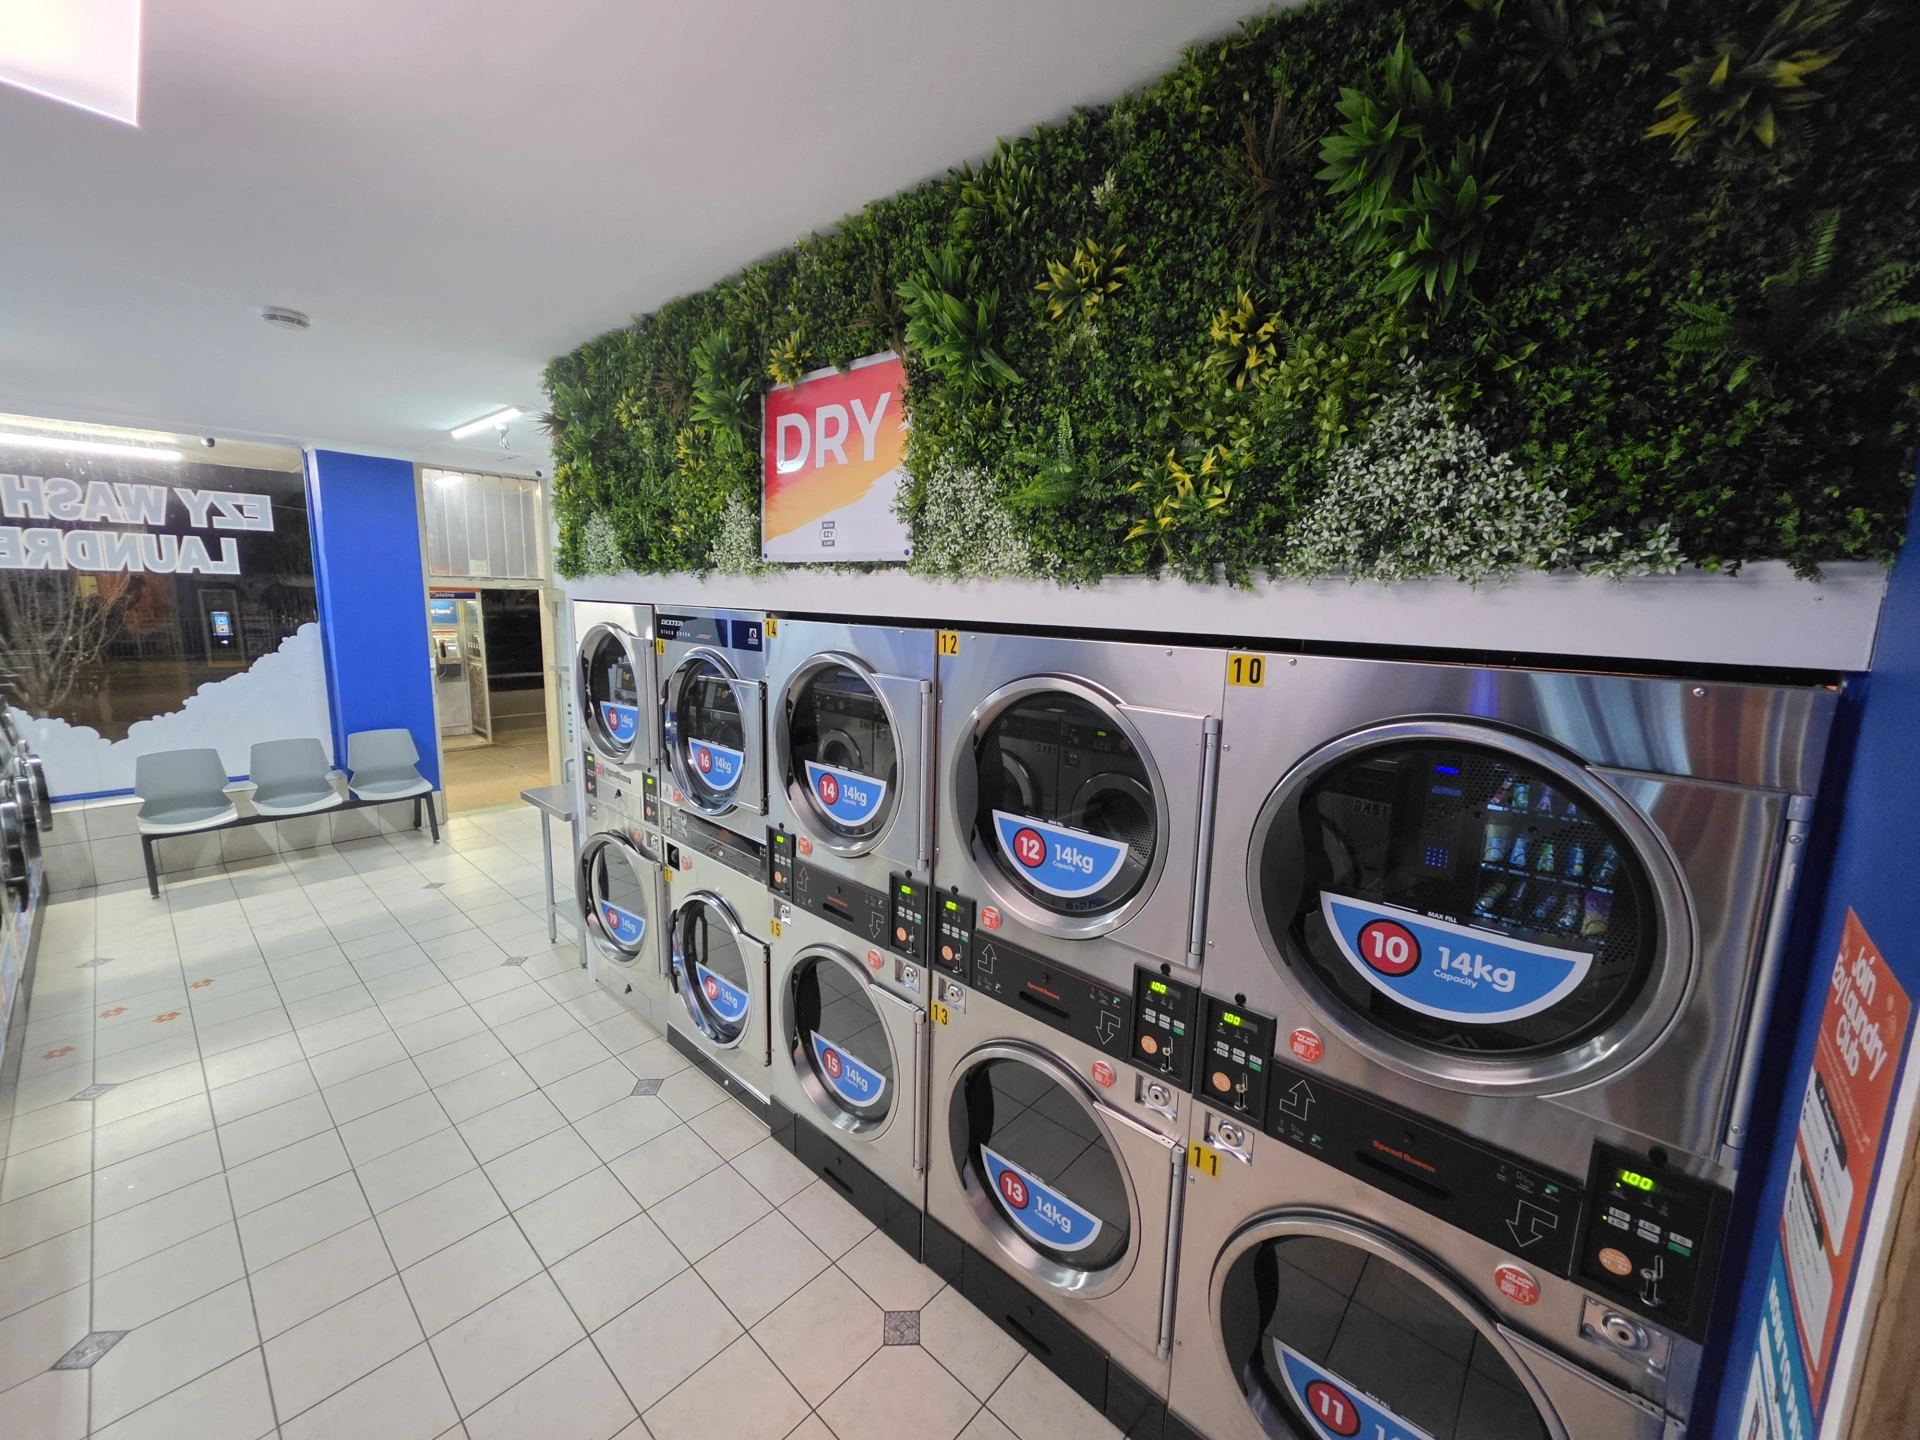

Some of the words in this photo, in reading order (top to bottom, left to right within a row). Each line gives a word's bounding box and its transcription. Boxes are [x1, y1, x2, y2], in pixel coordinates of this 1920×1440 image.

[777, 392, 891, 474] DRY
[661, 619, 684, 627] DEXTER
[766, 621, 777, 636] 14
[657, 640, 664, 653] 16
[941, 634, 957, 654] 12
[1234, 657, 1262, 685] 10
[609, 712, 617, 725] 18
[620, 714, 633, 728] 14kg
[700, 753, 710, 768] 16
[714, 756, 732, 774] 14kg
[822, 780, 835, 798] 14
[843, 784, 867, 807] 14kg
[1020, 836, 1040, 860] 12
[1052, 860, 1075, 873] Capacity
[1054, 844, 1094, 874] 14kg
[666, 869, 672, 881] 17
[608, 912, 617, 924] 19
[621, 917, 636, 933] 14kg
[1427, 911, 1444, 920] MAX
[1445, 914, 1458, 923] FILL
[770, 920, 781, 937] 15
[1371, 931, 1409, 964] 10
[1433, 969, 1478, 989] Capacity
[1438, 946, 1516, 993] 14kg
[1852, 947, 1876, 1006] Join
[707, 981, 716, 995] 17
[721, 988, 738, 1009] 14kg
[934, 1004, 948, 1025] 13
[1832, 953, 1849, 1005] Ezy
[1842, 976, 1887, 1082] Laundry
[1836, 1014, 1860, 1077] Club
[826, 1053, 838, 1073] 15
[845, 1065, 868, 1092] 14kg
[1194, 1147, 1217, 1176] 11
[1373, 1140, 1403, 1159] Speed
[1403, 1153, 1436, 1173] Queen
[1005, 1177, 1023, 1202] 13
[1036, 1195, 1071, 1234] 14kg
[1319, 1390, 1344, 1425] 11
